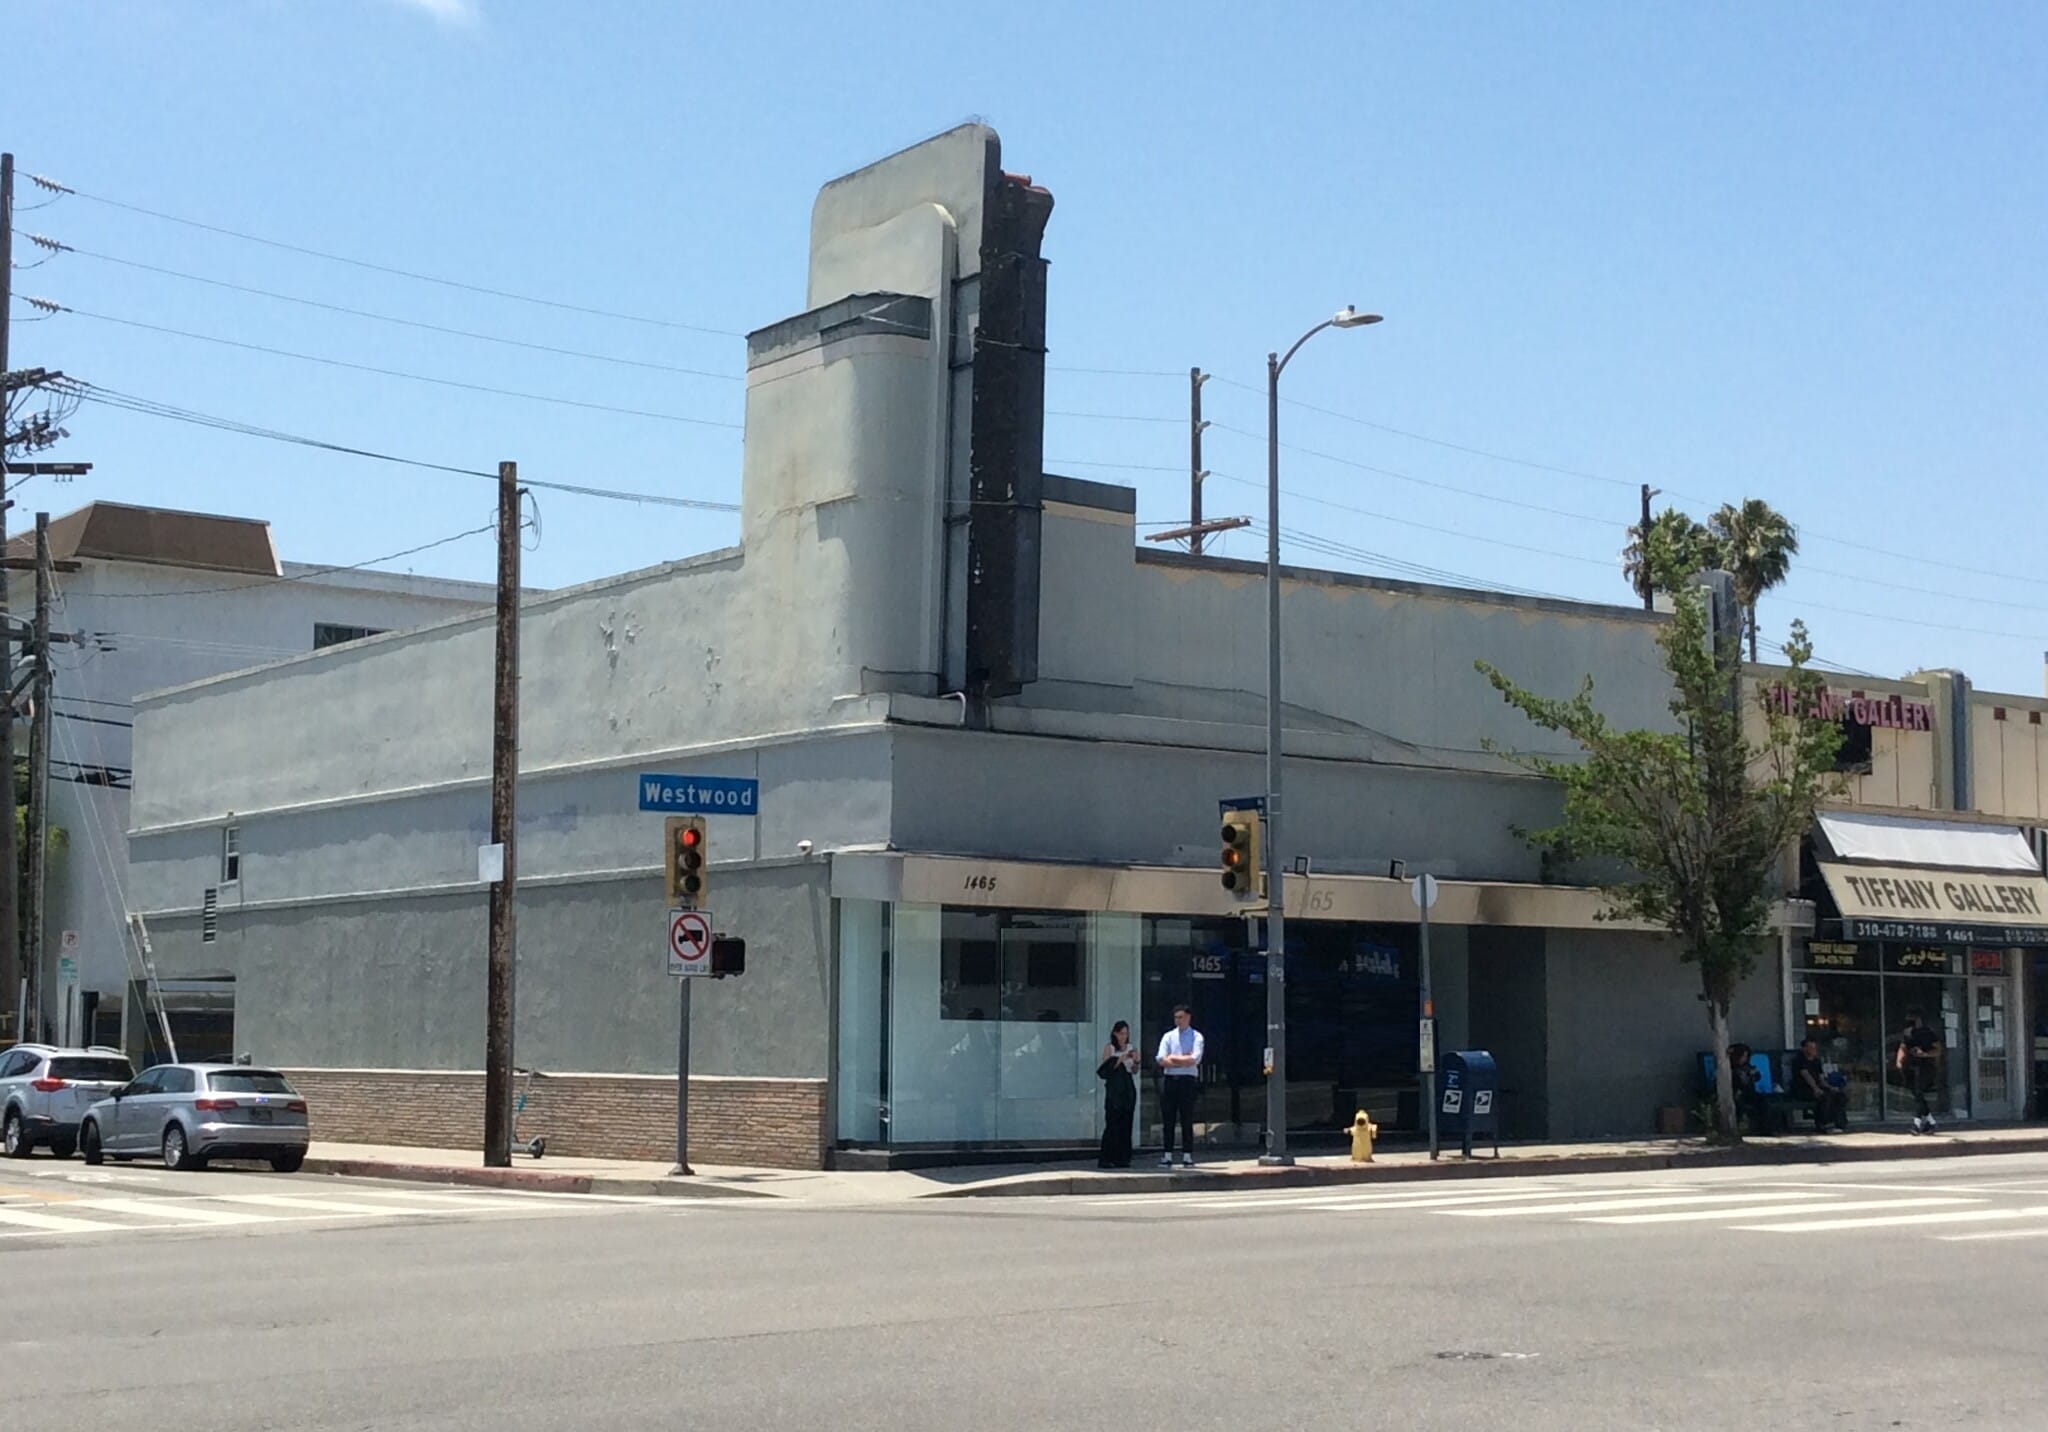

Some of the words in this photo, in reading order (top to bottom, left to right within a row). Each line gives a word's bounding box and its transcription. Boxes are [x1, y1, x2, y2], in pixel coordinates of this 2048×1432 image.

[1853, 697, 1935, 731] GALLERY
[645, 782, 752, 806] Westwood
[964, 876, 997, 891] 1465
[1845, 876, 1941, 910] TIFFANY
[1944, 882, 2041, 915] GALLERY
[1946, 930, 1974, 941] 1461
[1192, 956, 1221, 971] 1465
